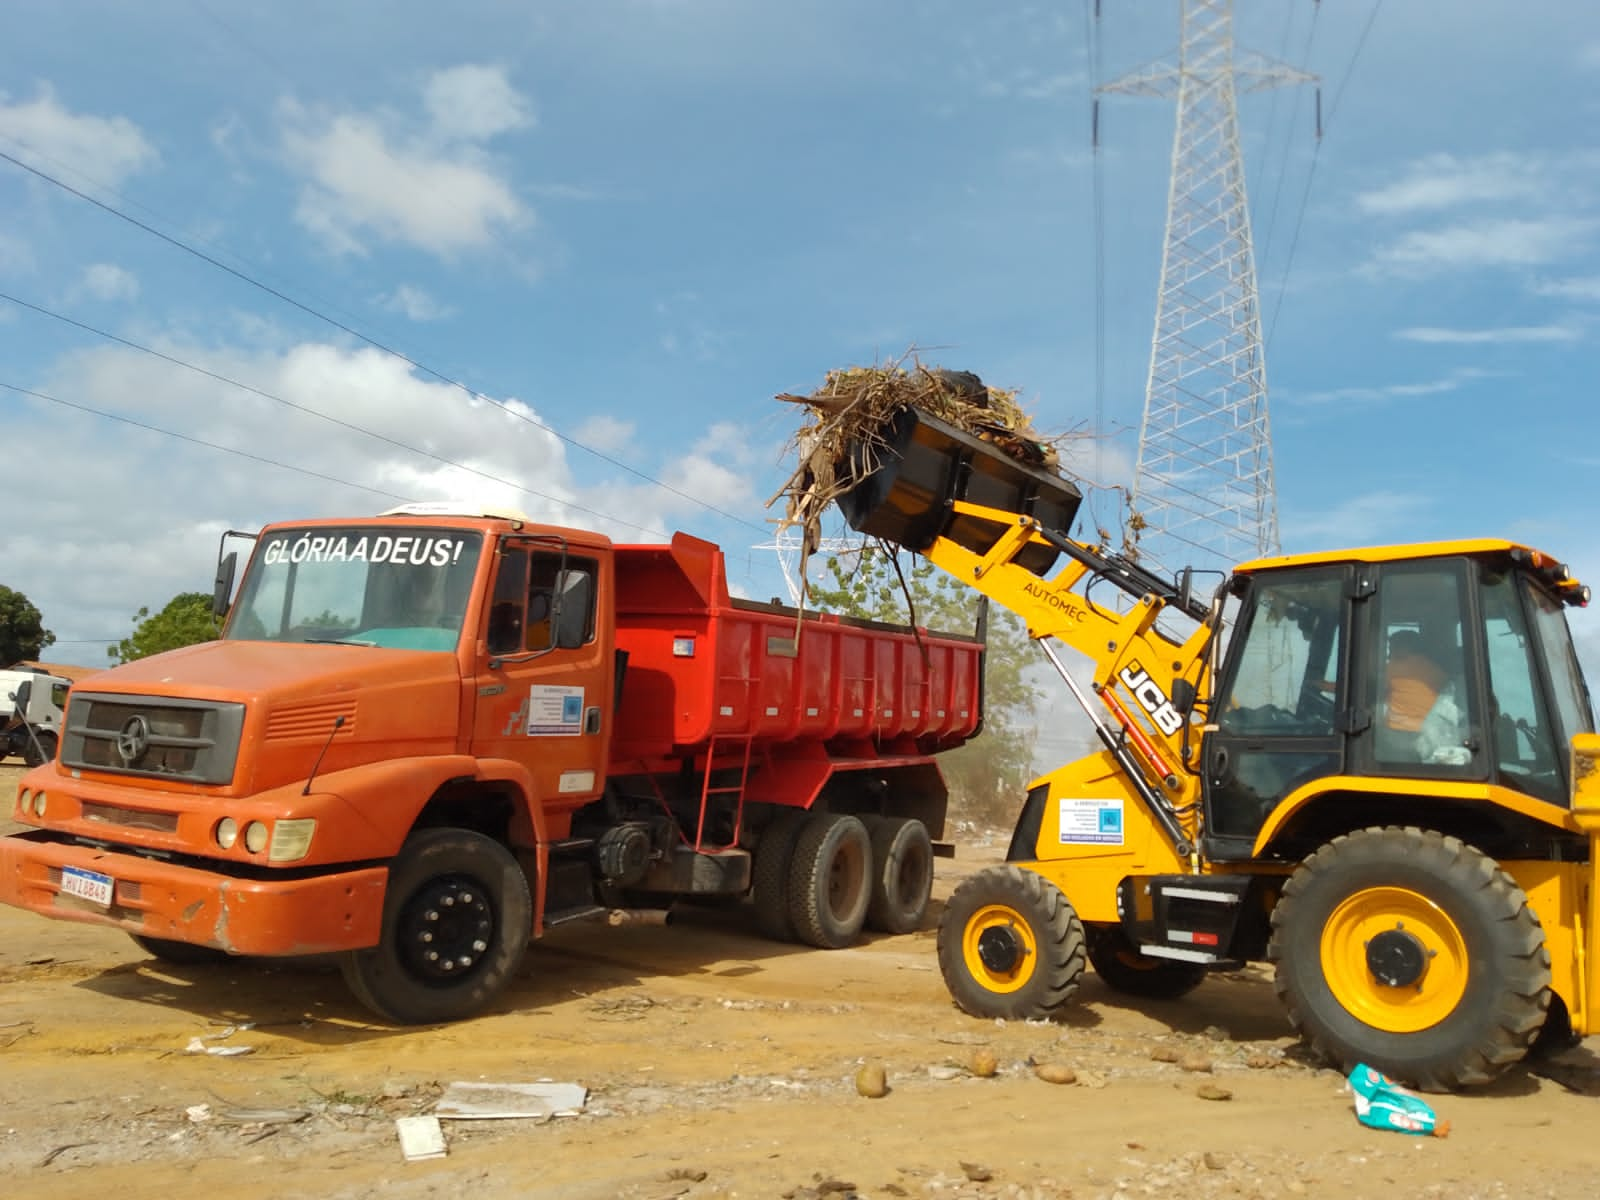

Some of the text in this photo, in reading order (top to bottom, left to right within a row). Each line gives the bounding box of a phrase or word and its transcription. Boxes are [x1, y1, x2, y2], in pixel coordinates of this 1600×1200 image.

[263, 531, 464, 567] GLÓRIA A DEUS!
[1023, 582, 1089, 623] AUTOMEC
[1119, 666, 1184, 736] JCB
